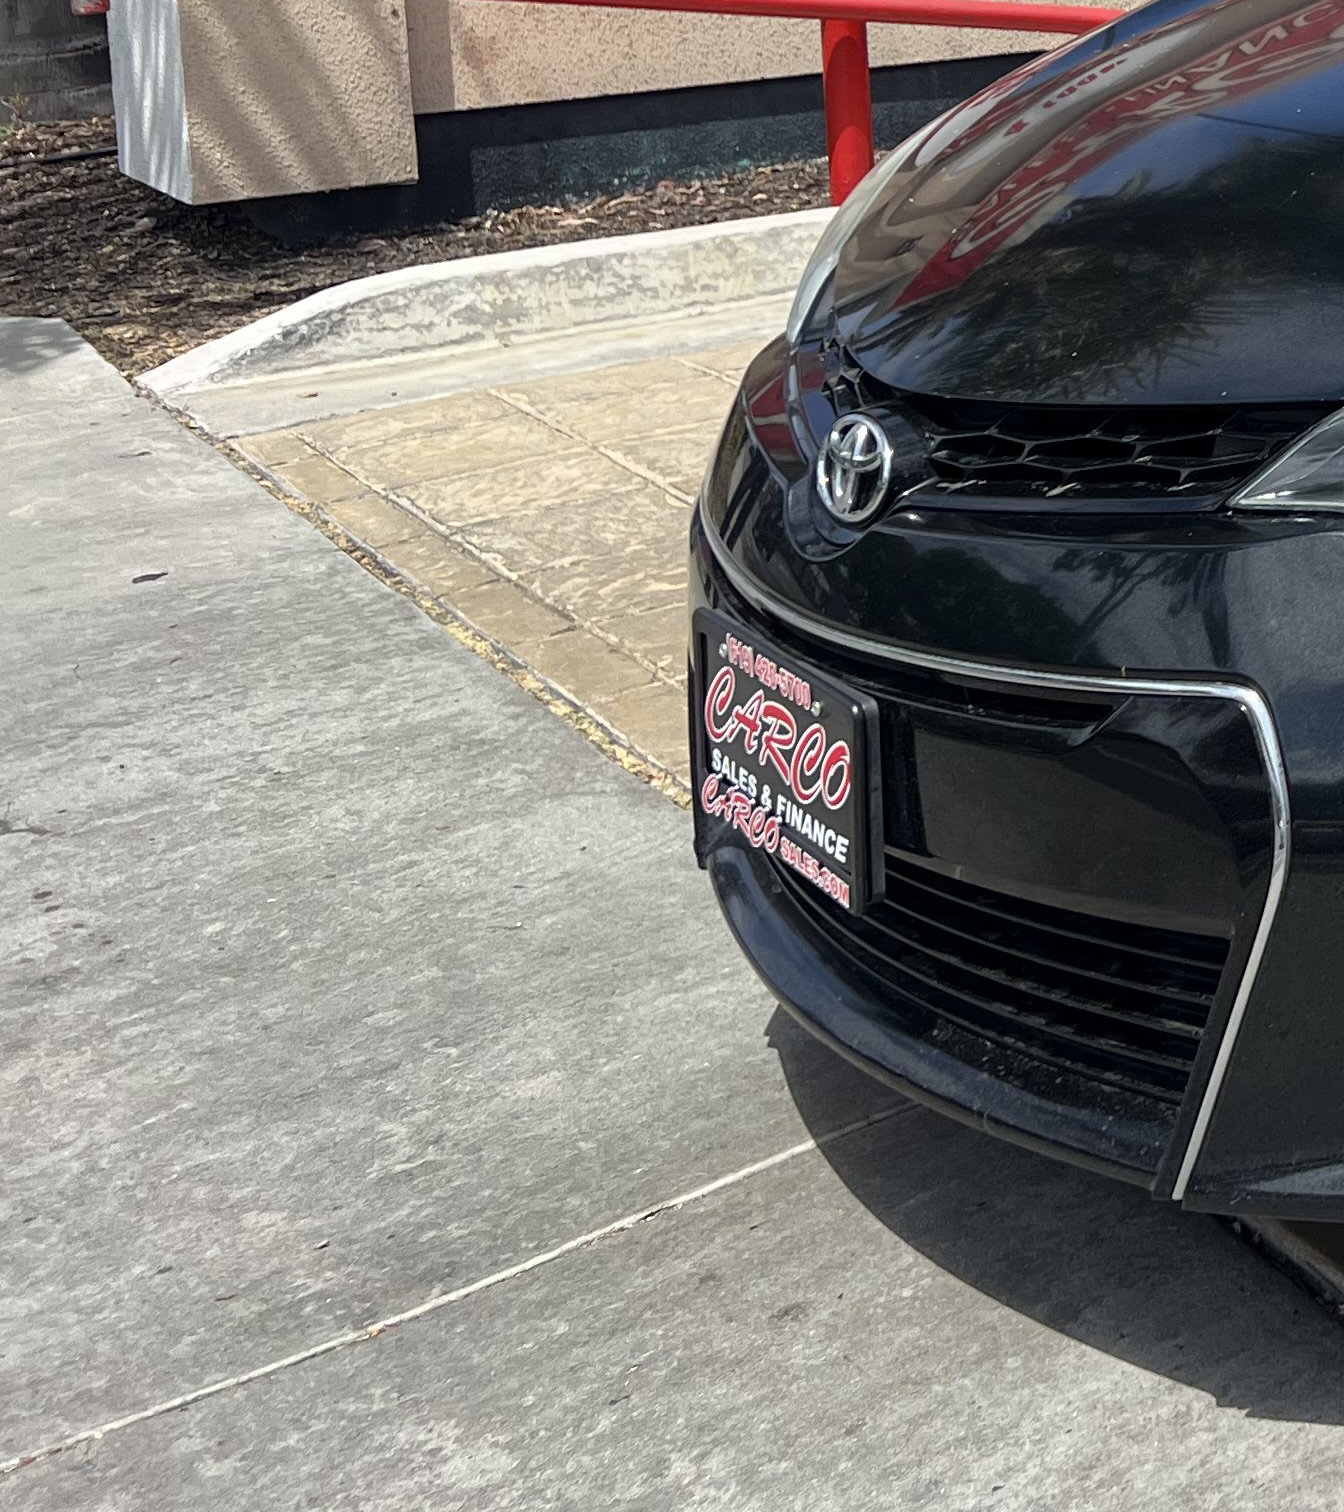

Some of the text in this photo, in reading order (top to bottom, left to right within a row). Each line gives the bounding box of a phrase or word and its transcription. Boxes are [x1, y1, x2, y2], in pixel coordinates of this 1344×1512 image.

[705, 666, 850, 810] CARCO
[702, 773, 780, 853] CARCO
[711, 748, 850, 864] SALES & FINANCE
